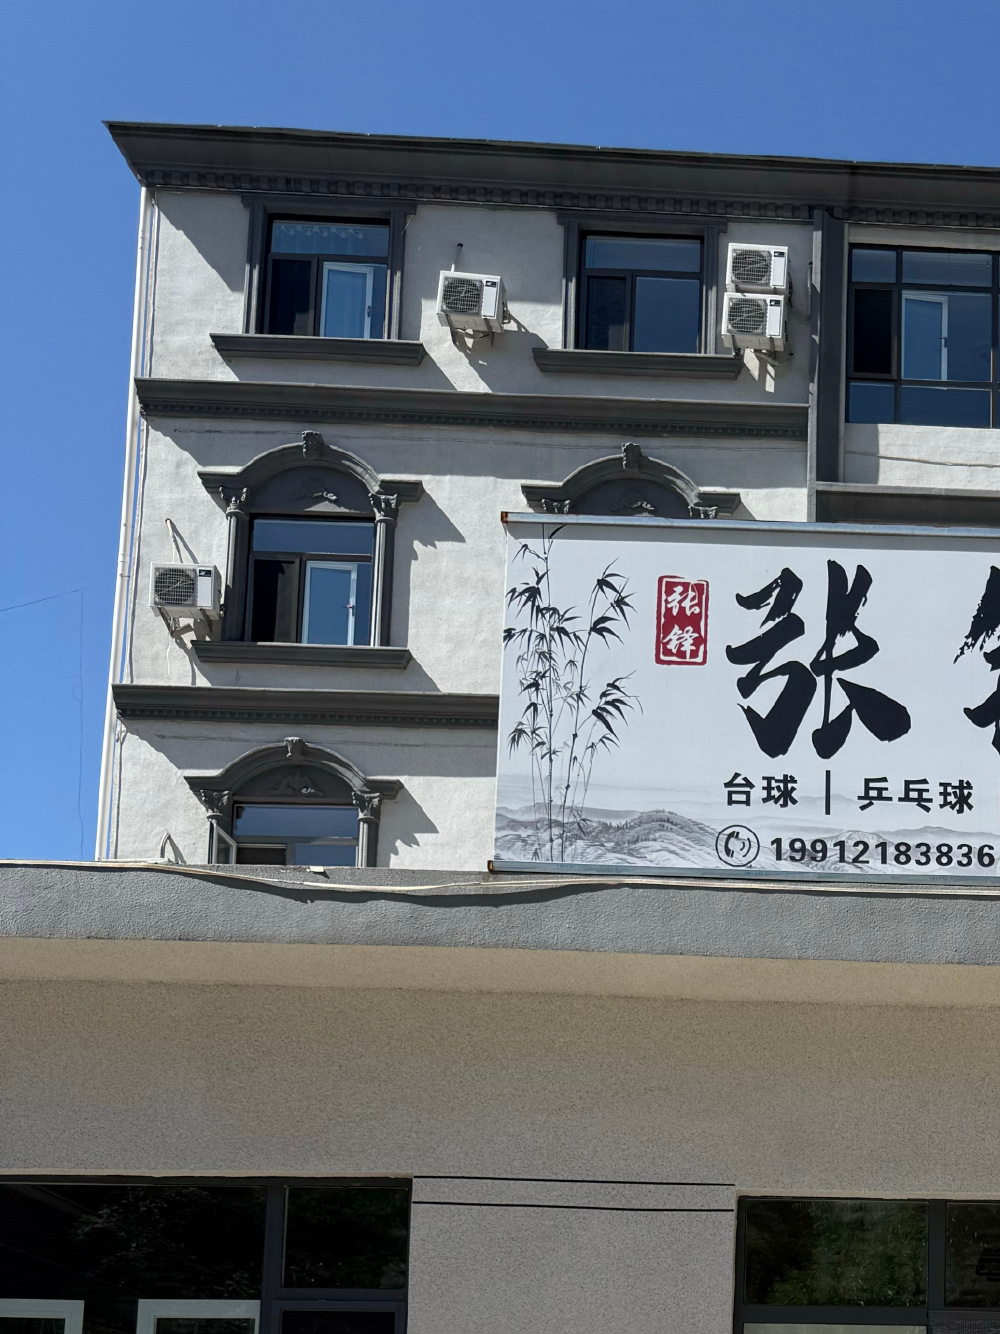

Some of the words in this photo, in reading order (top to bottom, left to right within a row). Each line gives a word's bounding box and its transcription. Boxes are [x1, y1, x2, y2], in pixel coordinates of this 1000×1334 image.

[723, 773, 799, 809] 台球
[857, 777, 974, 815] 乒乓球
[771, 838, 996, 868] 19912183836
